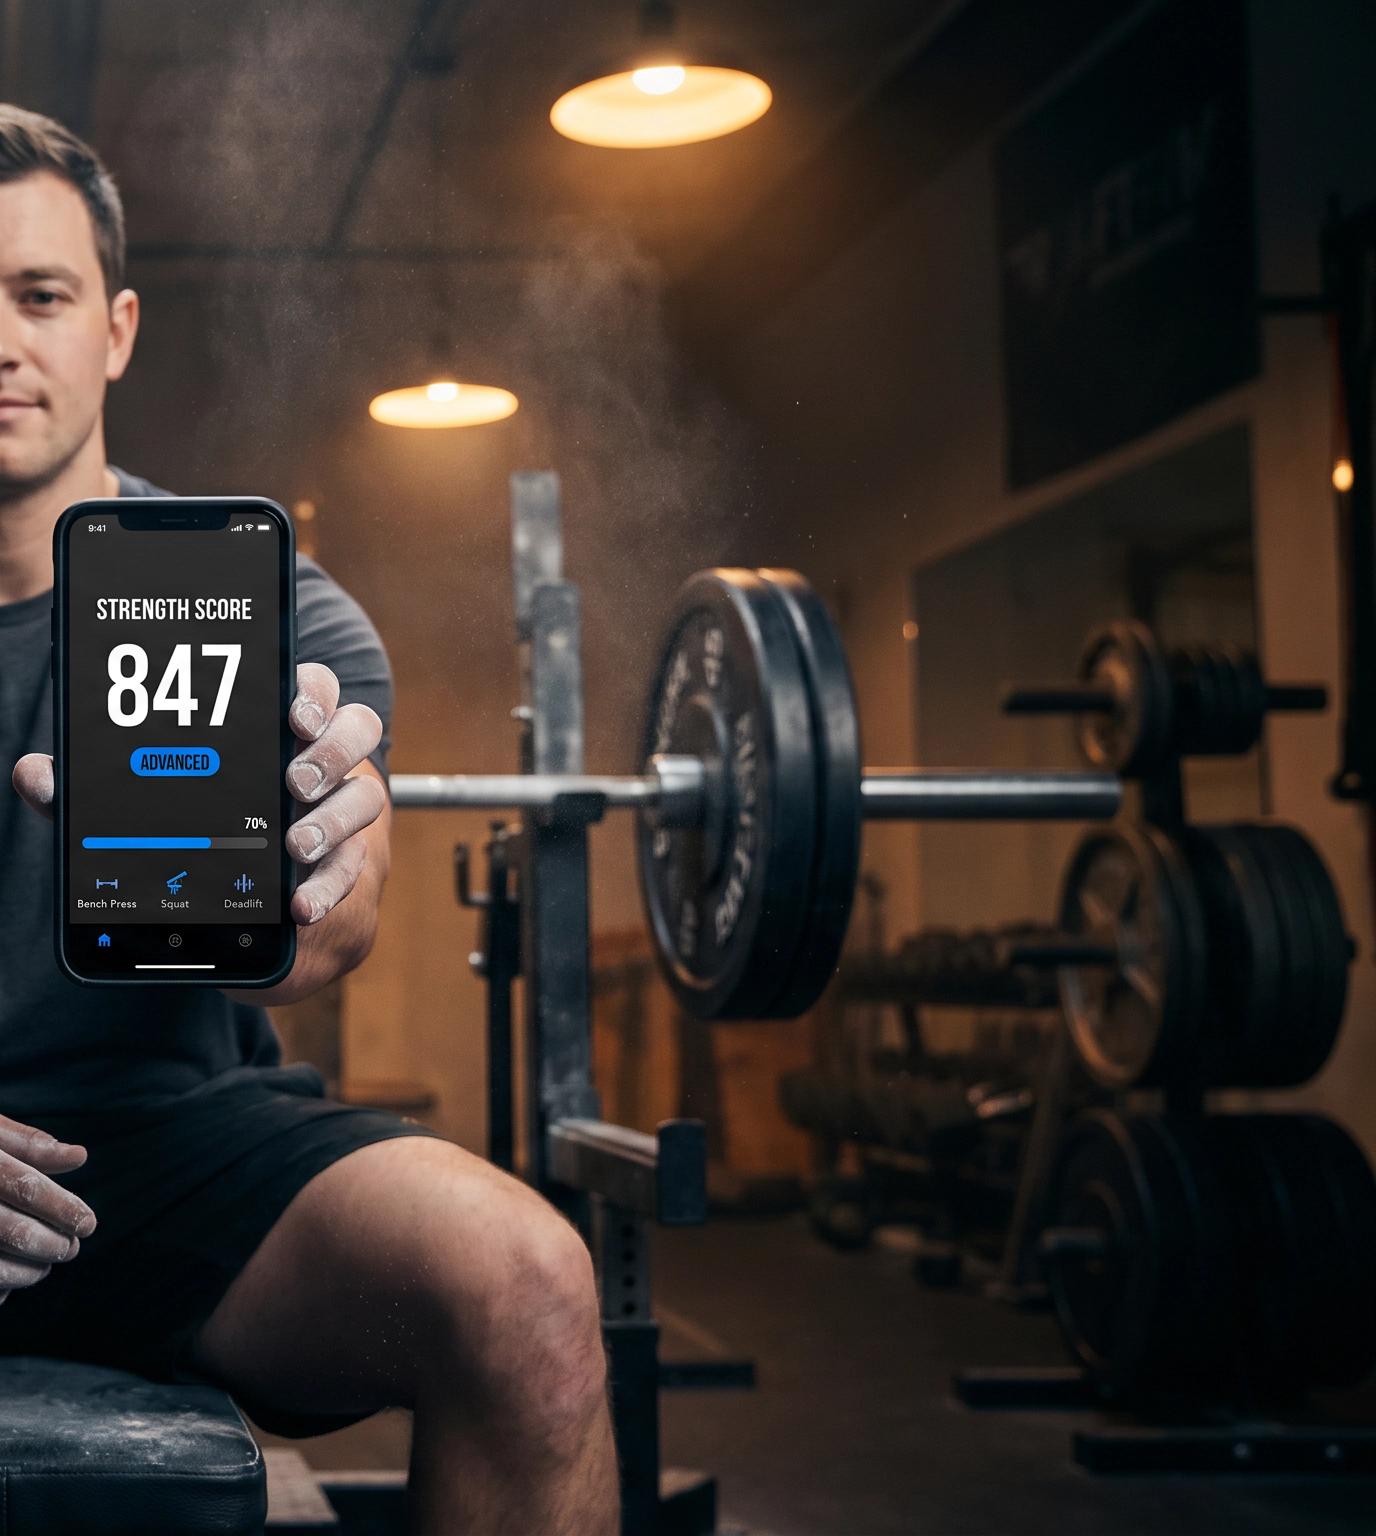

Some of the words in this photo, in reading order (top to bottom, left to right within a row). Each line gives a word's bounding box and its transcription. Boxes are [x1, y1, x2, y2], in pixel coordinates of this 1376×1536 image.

[88, 524, 106, 533] 9:41
[96, 598, 190, 621] STRENGTH
[194, 598, 252, 621] SCORE
[107, 643, 242, 728] 847
[140, 754, 210, 771] ADVANCED
[244, 817, 268, 830] 70%
[77, 899, 108, 909] Bench
[110, 899, 137, 909] Press
[160, 899, 190, 910] Squat
[224, 898, 263, 909] Deadlift
